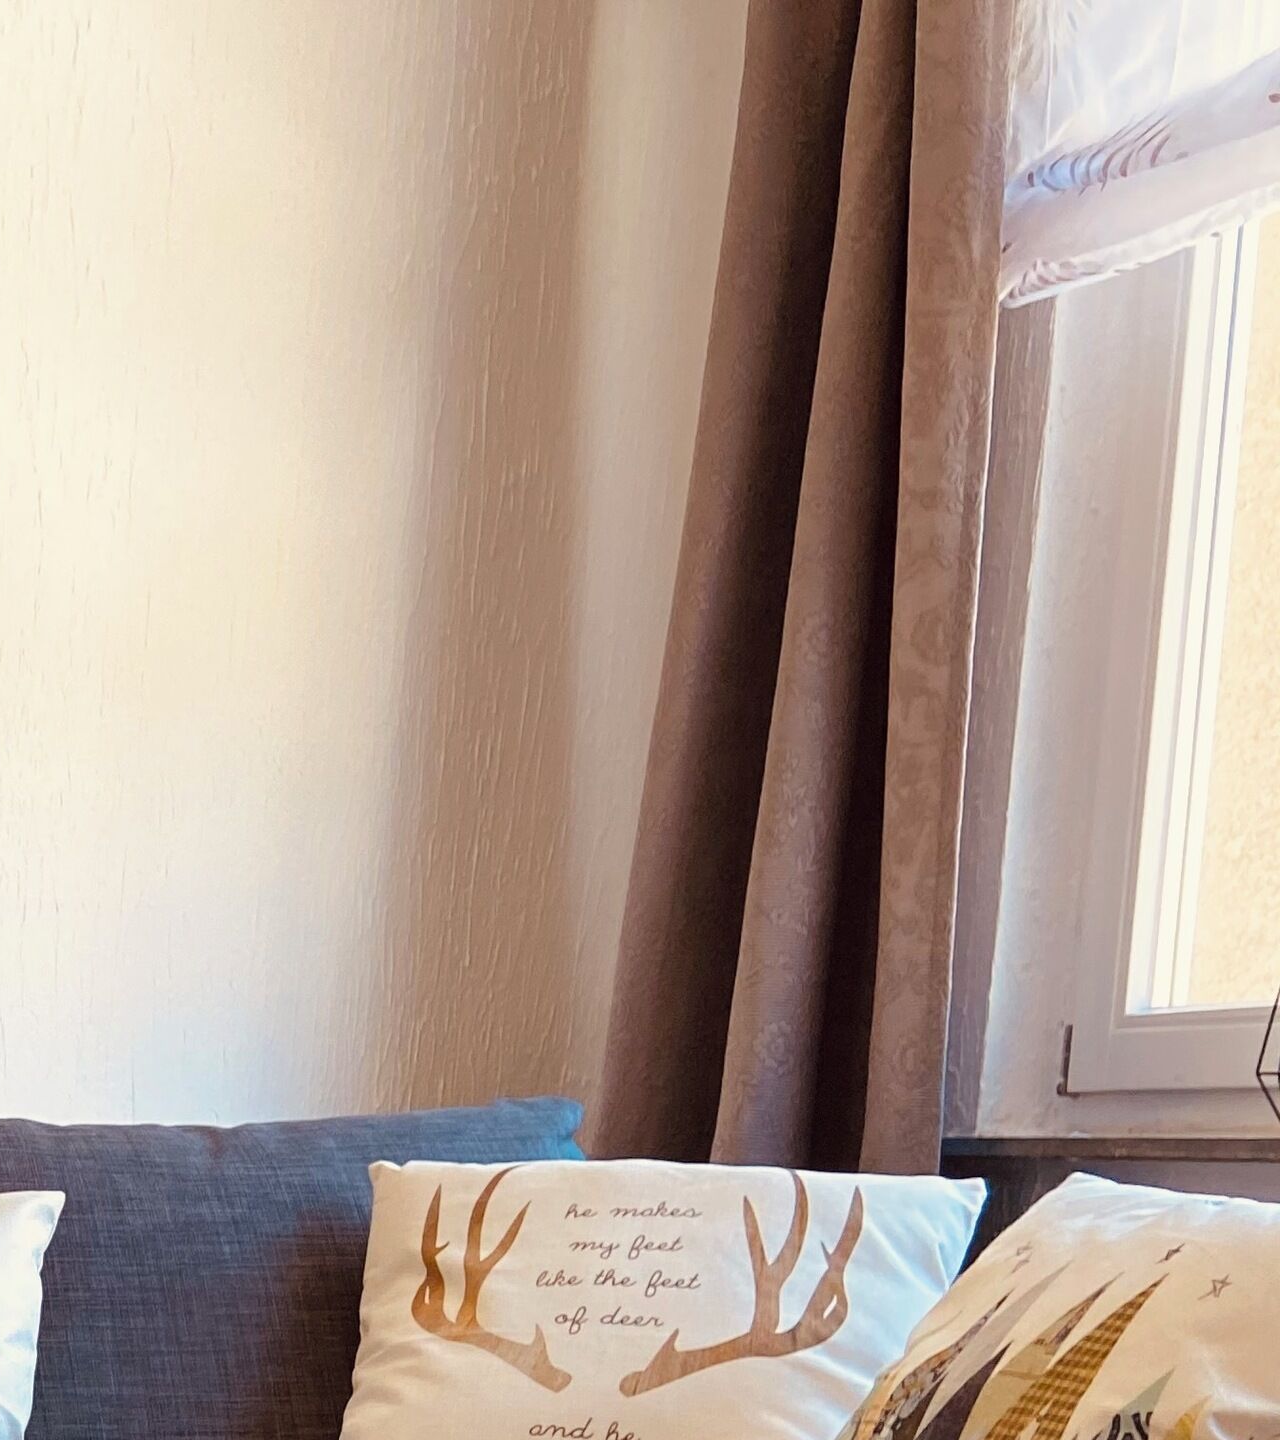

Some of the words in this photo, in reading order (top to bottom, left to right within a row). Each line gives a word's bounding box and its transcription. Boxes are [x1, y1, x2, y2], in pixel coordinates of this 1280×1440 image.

[565, 1203, 597, 1219] he
[610, 1201, 703, 1218] makes
[569, 1239, 620, 1259] my
[627, 1235, 683, 1260] feet
[536, 1269, 583, 1287] like
[594, 1268, 636, 1286] the
[644, 1270, 701, 1298] feet
[554, 1306, 588, 1335] of
[600, 1306, 664, 1327] deer
[529, 1417, 594, 1440] and
